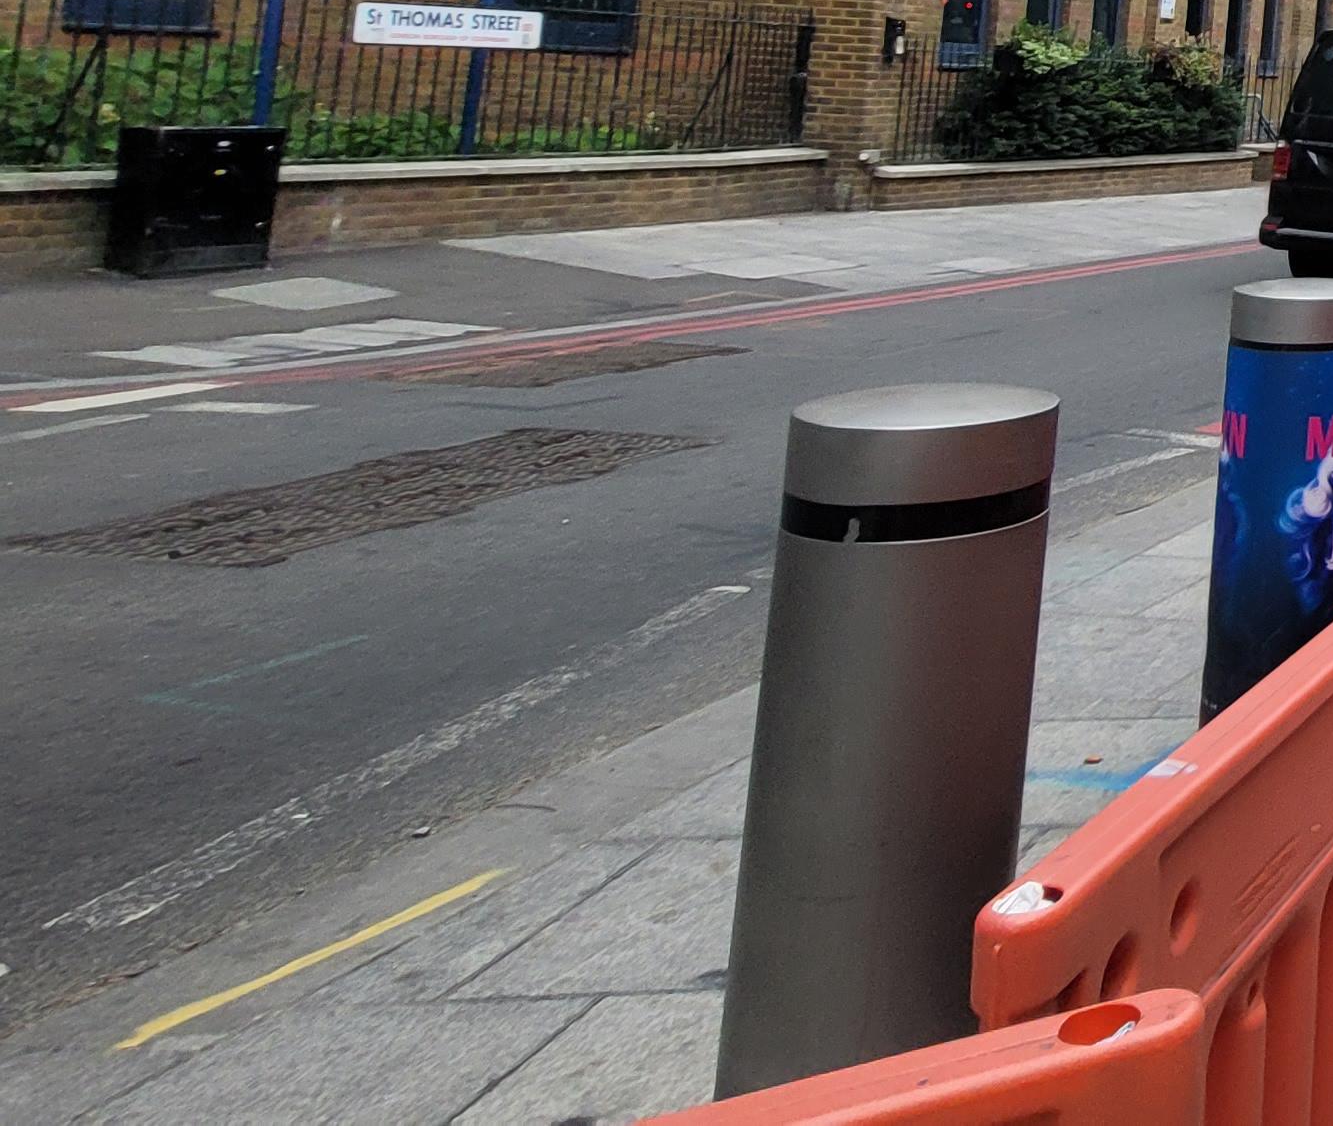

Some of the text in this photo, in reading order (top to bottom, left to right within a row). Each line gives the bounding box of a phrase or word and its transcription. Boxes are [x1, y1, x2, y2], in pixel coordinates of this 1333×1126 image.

[367, 8, 383, 25] St
[391, 9, 464, 29] THOMAS
[472, 14, 522, 32] STREET
